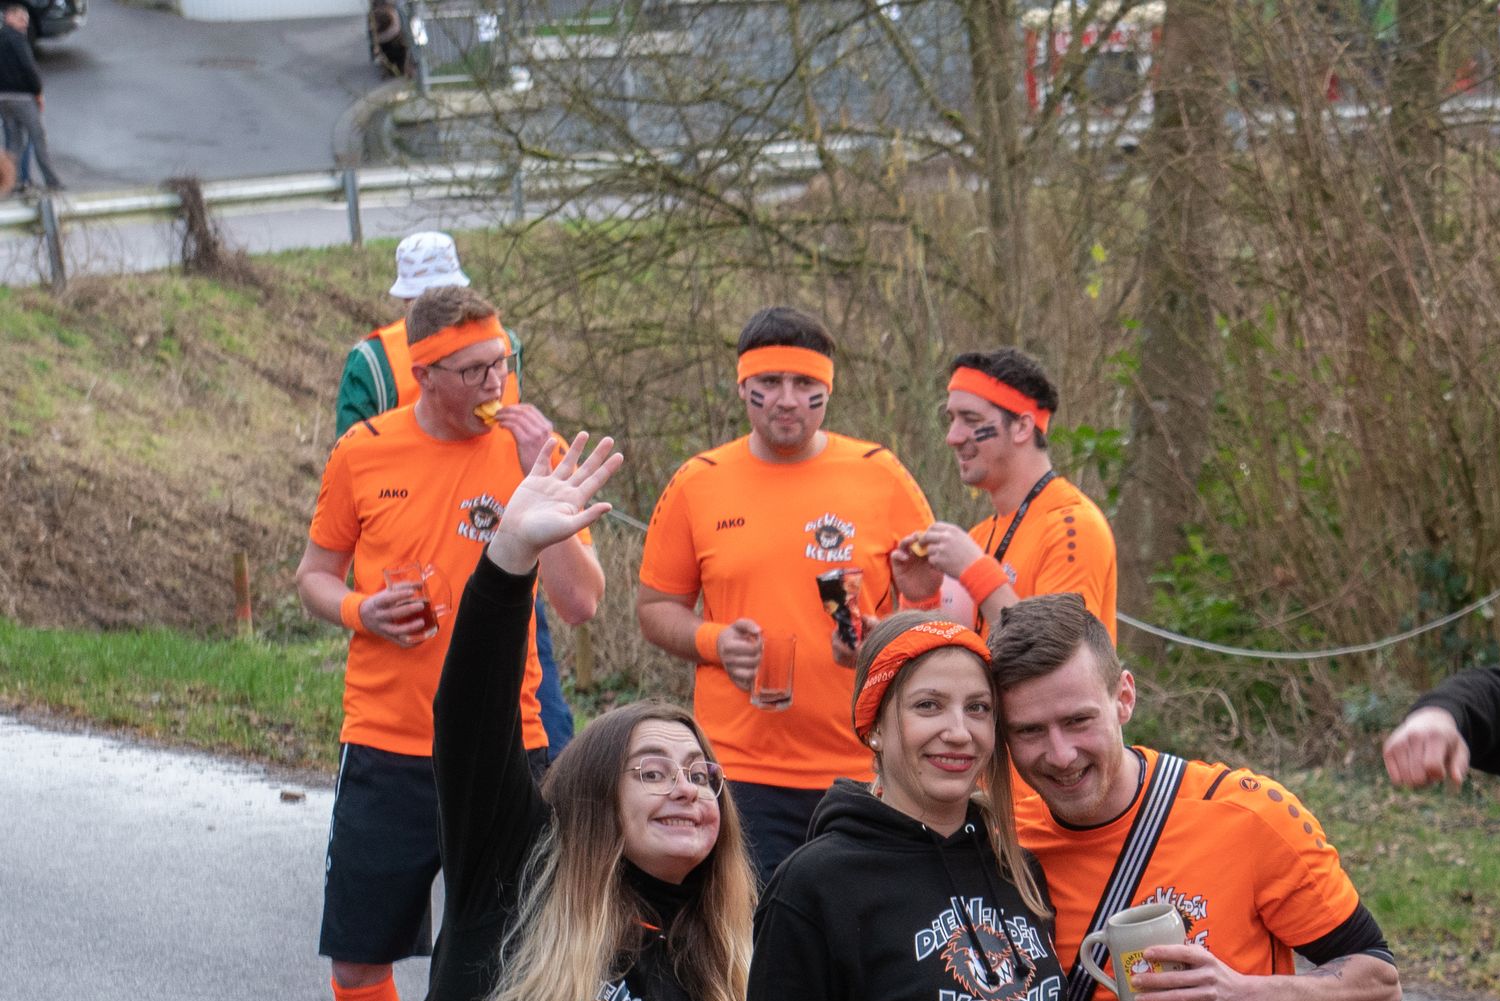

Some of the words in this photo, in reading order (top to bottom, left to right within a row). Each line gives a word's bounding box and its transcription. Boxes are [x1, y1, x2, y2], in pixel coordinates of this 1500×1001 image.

[378, 488, 409, 499] JAKO
[716, 517, 746, 531] JAKO
[805, 543, 854, 562] KERLE
